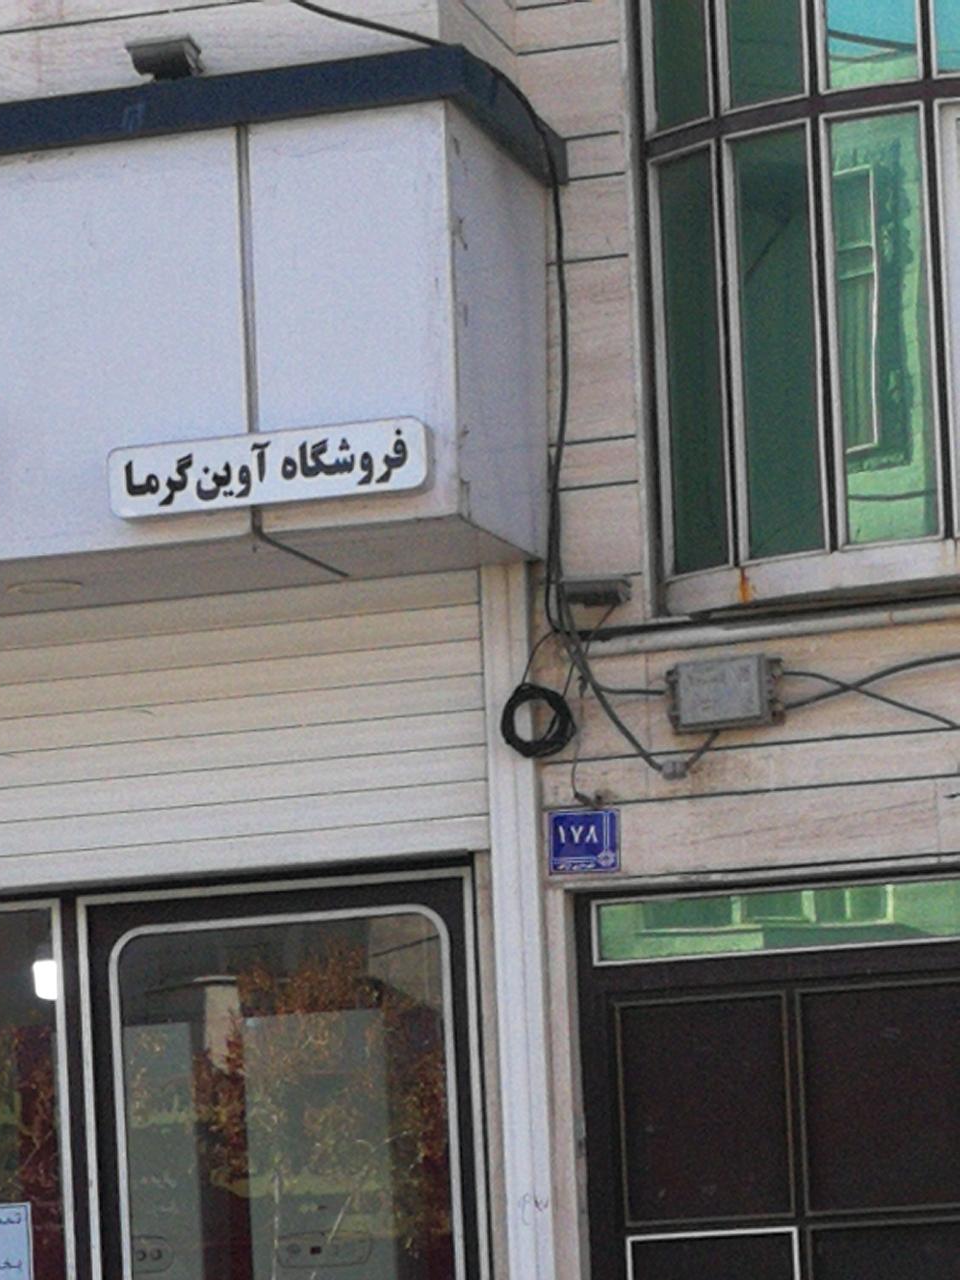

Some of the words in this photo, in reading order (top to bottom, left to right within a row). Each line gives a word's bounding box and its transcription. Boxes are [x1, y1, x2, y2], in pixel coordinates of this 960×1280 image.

[123, 454, 193, 507] گرما
[195, 441, 271, 501] آوین
[280, 428, 408, 486] فروشگاه
[558, 824, 599, 844] ۱۷۸
